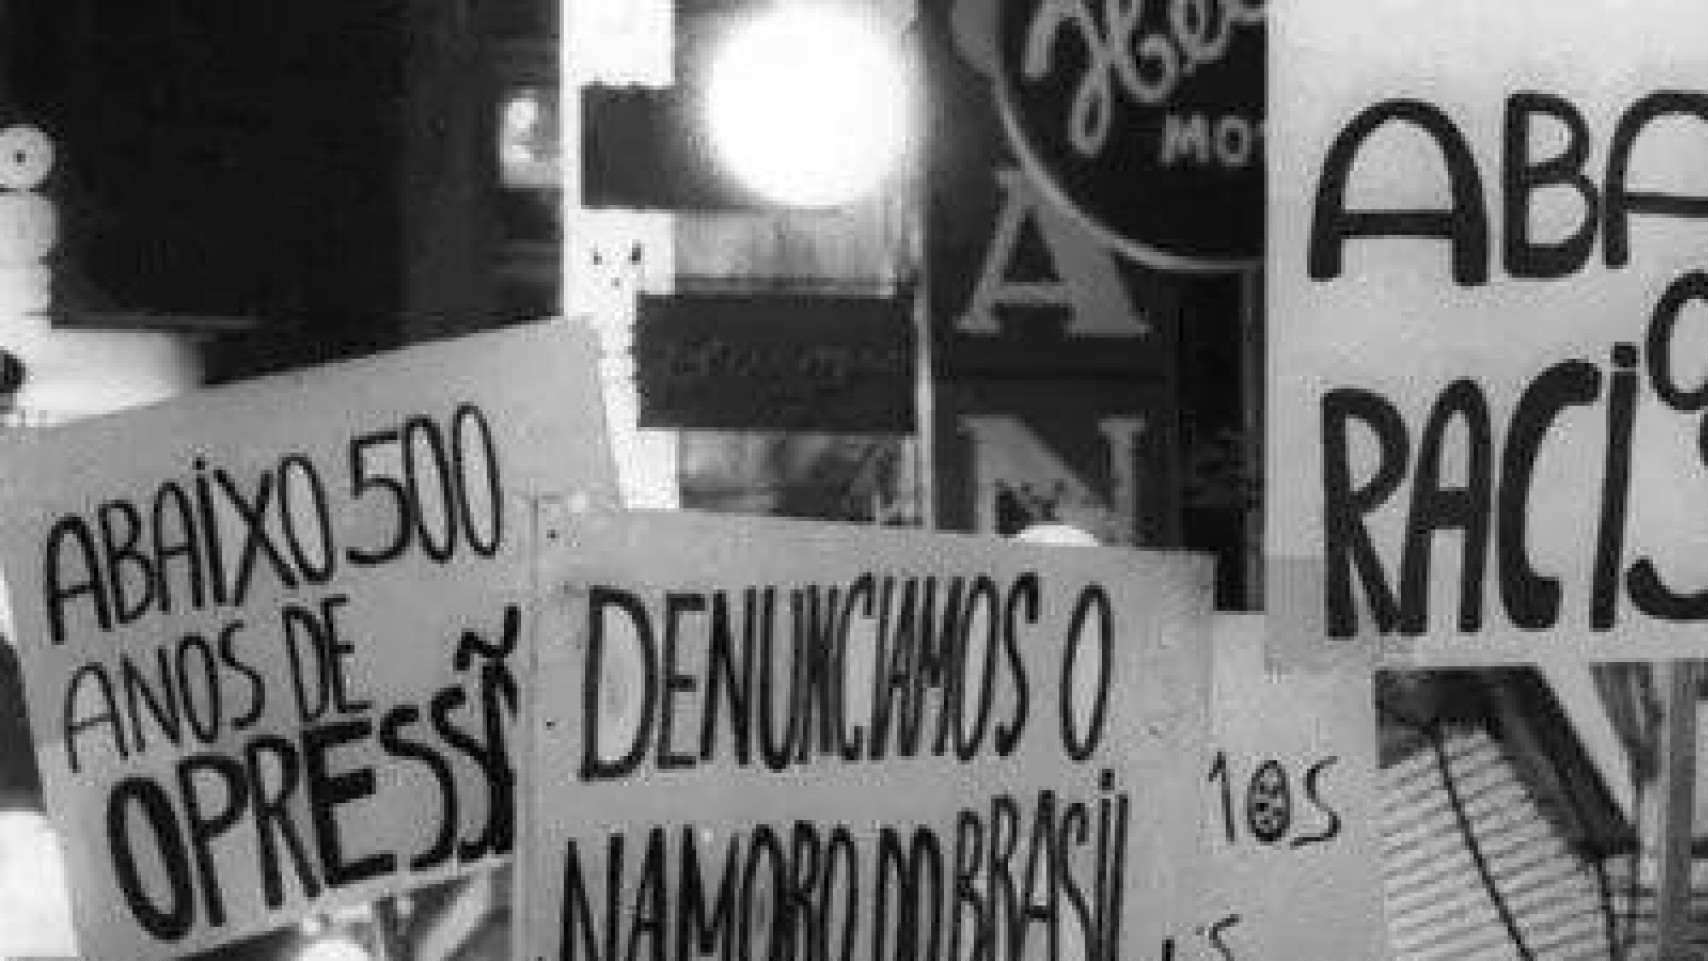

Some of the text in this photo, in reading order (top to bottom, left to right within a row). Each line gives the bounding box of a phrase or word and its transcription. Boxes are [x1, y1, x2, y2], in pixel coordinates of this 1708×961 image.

[44, 402, 502, 645] ABAIXO 500
[63, 595, 375, 774] ANOS DE
[578, 572, 1112, 782] DENUNCIAMOS O
